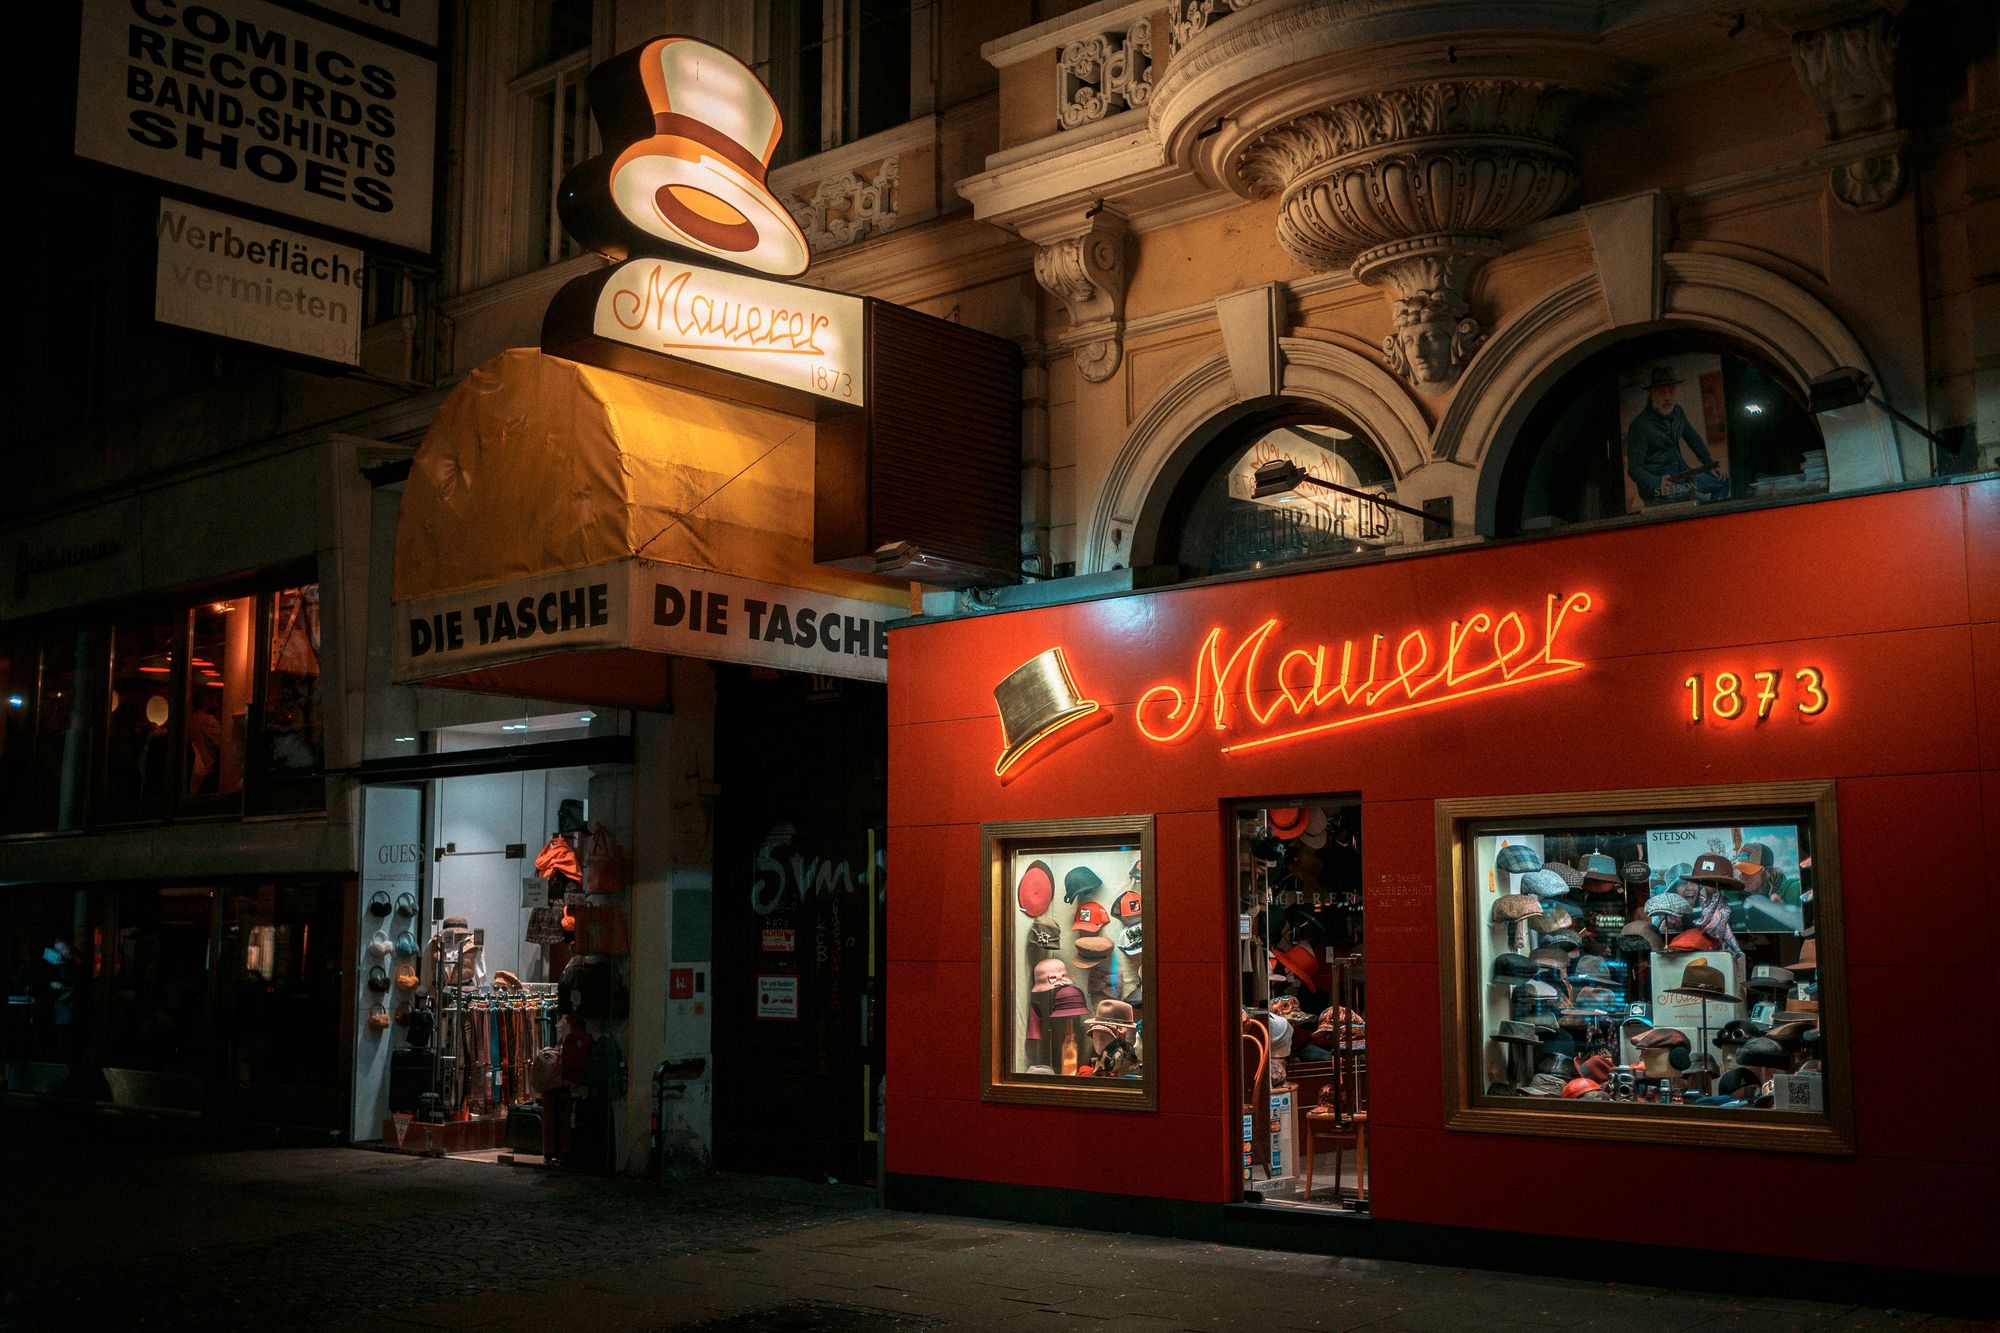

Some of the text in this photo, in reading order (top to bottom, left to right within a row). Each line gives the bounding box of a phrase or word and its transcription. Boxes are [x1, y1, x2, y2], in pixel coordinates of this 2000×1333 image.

[129, 24, 396, 138] RECORDS
[131, 0, 397, 100] COMICS
[126, 64, 396, 177] BAND-SHIRTS
[127, 110, 394, 213] SHOES
[173, 262, 348, 325] vermieten
[612, 264, 829, 356] Mauerer
[810, 363, 853, 398] 1873
[410, 583, 608, 657] DIE TASCHE
[654, 583, 888, 660] DIE TASCHE
[1136, 592, 1592, 742] Mauerer
[1684, 667, 1829, 721] 1873
[378, 843, 425, 865] GUESS
[1652, 831, 1696, 842] STETSON
